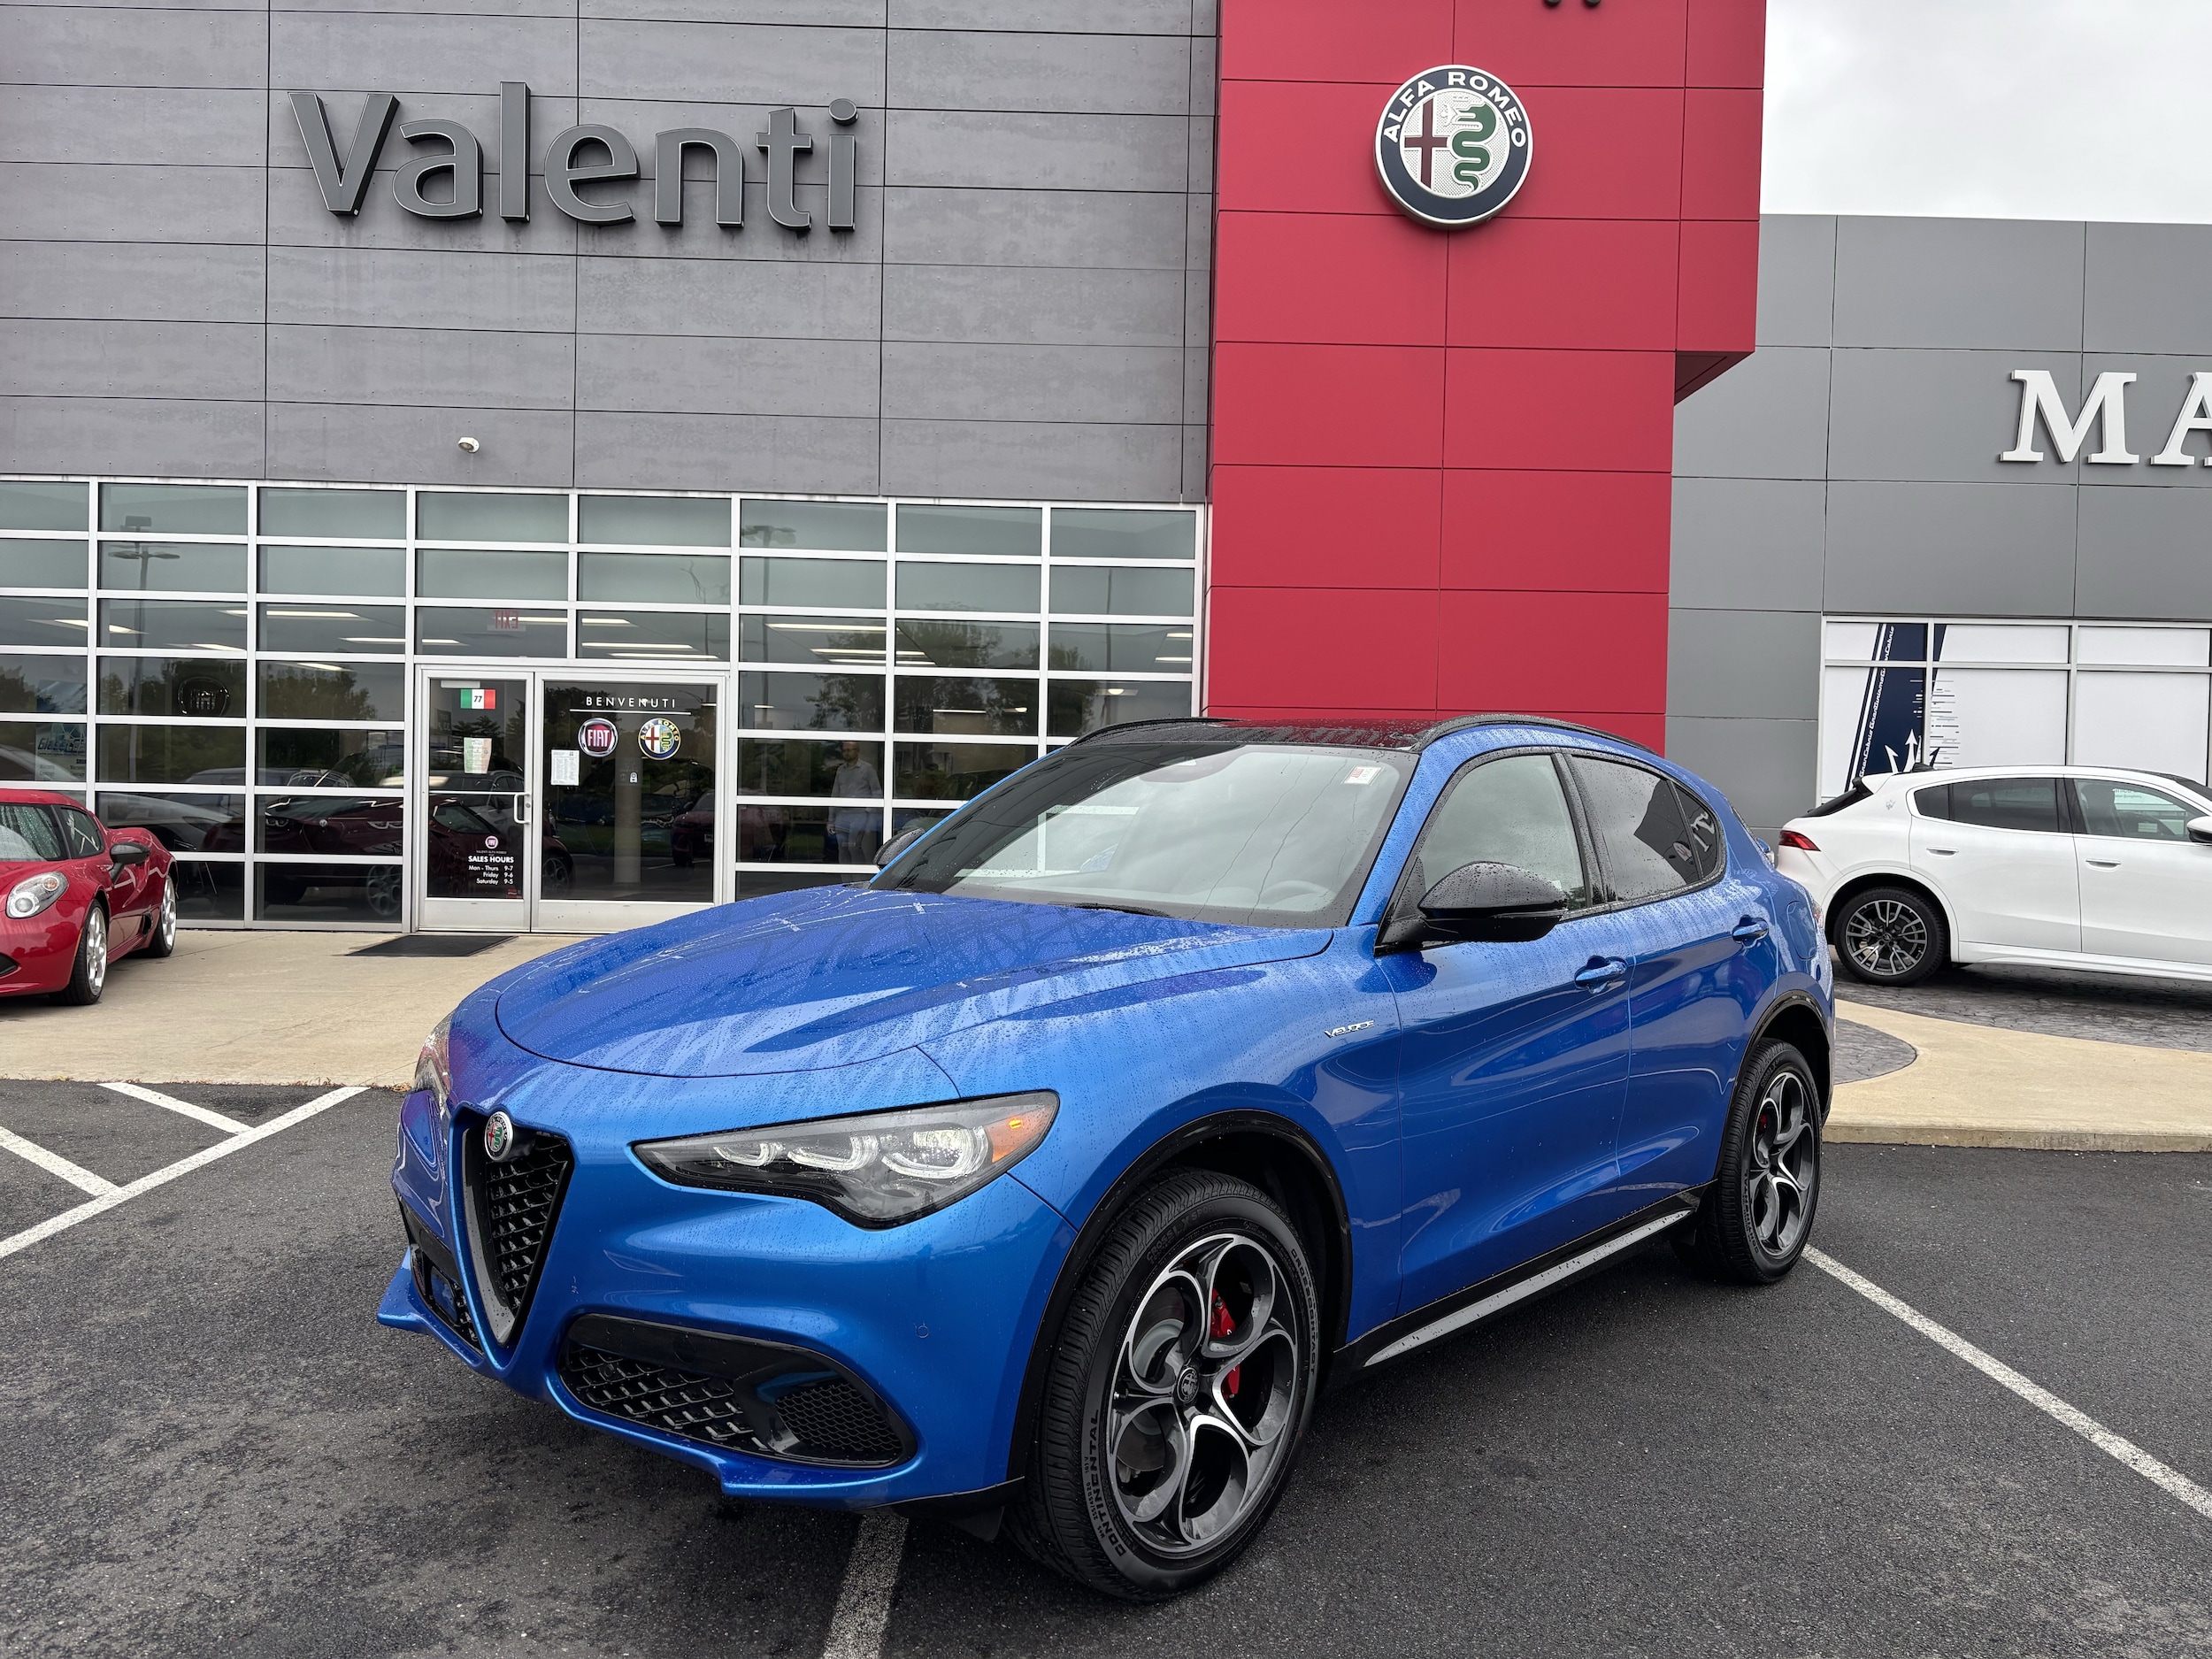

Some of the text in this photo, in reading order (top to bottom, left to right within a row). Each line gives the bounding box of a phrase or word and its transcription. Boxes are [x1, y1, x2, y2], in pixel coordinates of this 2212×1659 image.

[1384, 71, 1526, 148] ALFA ROMEO
[288, 81, 858, 231] Valenti
[586, 696, 675, 708] BENVENUTI
[588, 729, 610, 748] FIAT
[640, 719, 680, 741] ALFA ROMEO
[1089, 1409, 1126, 1557] CONTINENTAL
